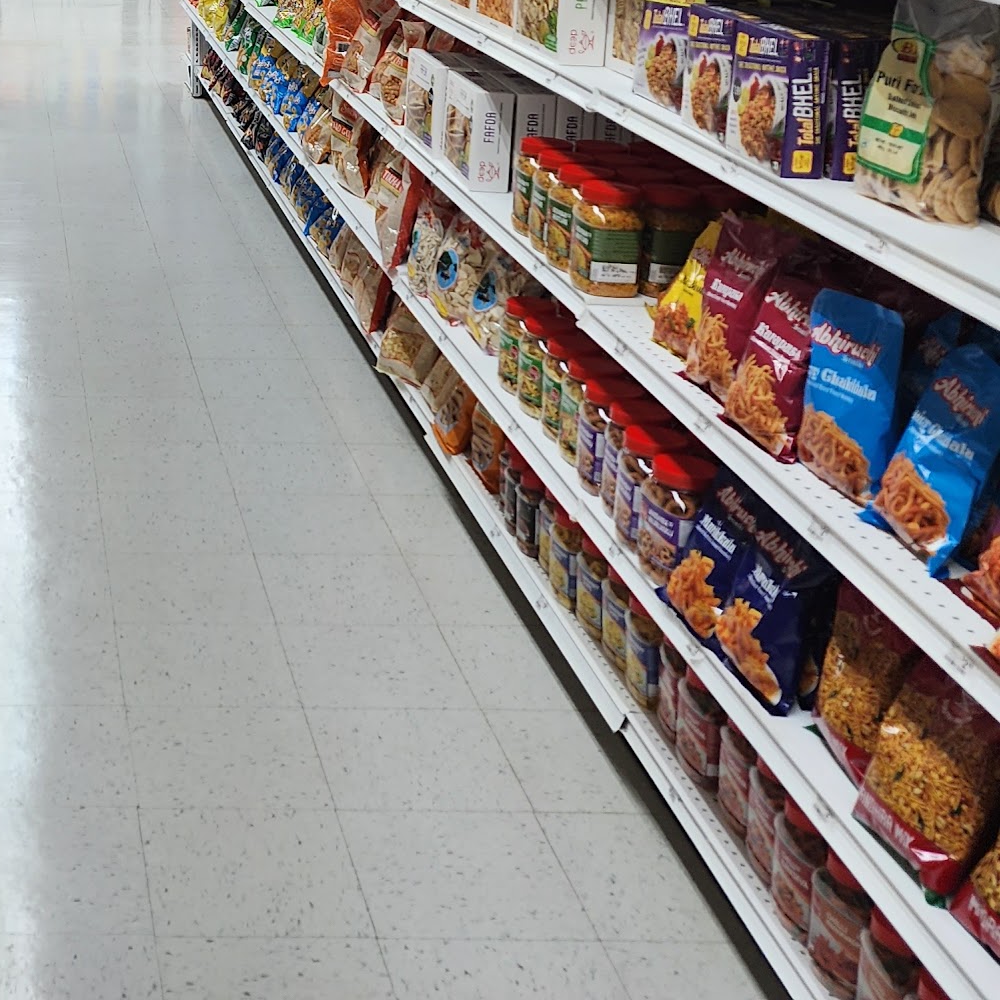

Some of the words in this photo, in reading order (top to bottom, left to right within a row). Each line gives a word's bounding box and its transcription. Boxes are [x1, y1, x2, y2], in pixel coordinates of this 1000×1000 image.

[663, 6, 685, 26] BHEL
[708, 17, 725, 36] BHEL
[569, 28, 578, 55] deep
[760, 36, 780, 57] BHEL
[877, 70, 900, 89] Puri
[791, 77, 815, 119] BHEL
[841, 78, 863, 119] BHEL
[483, 112, 498, 144] FAFDA
[527, 112, 540, 137] AFDA
[565, 115, 578, 141] AFDA
[797, 118, 814, 147] Total
[477, 161, 487, 183] deep
[764, 291, 812, 328] Abhiru
